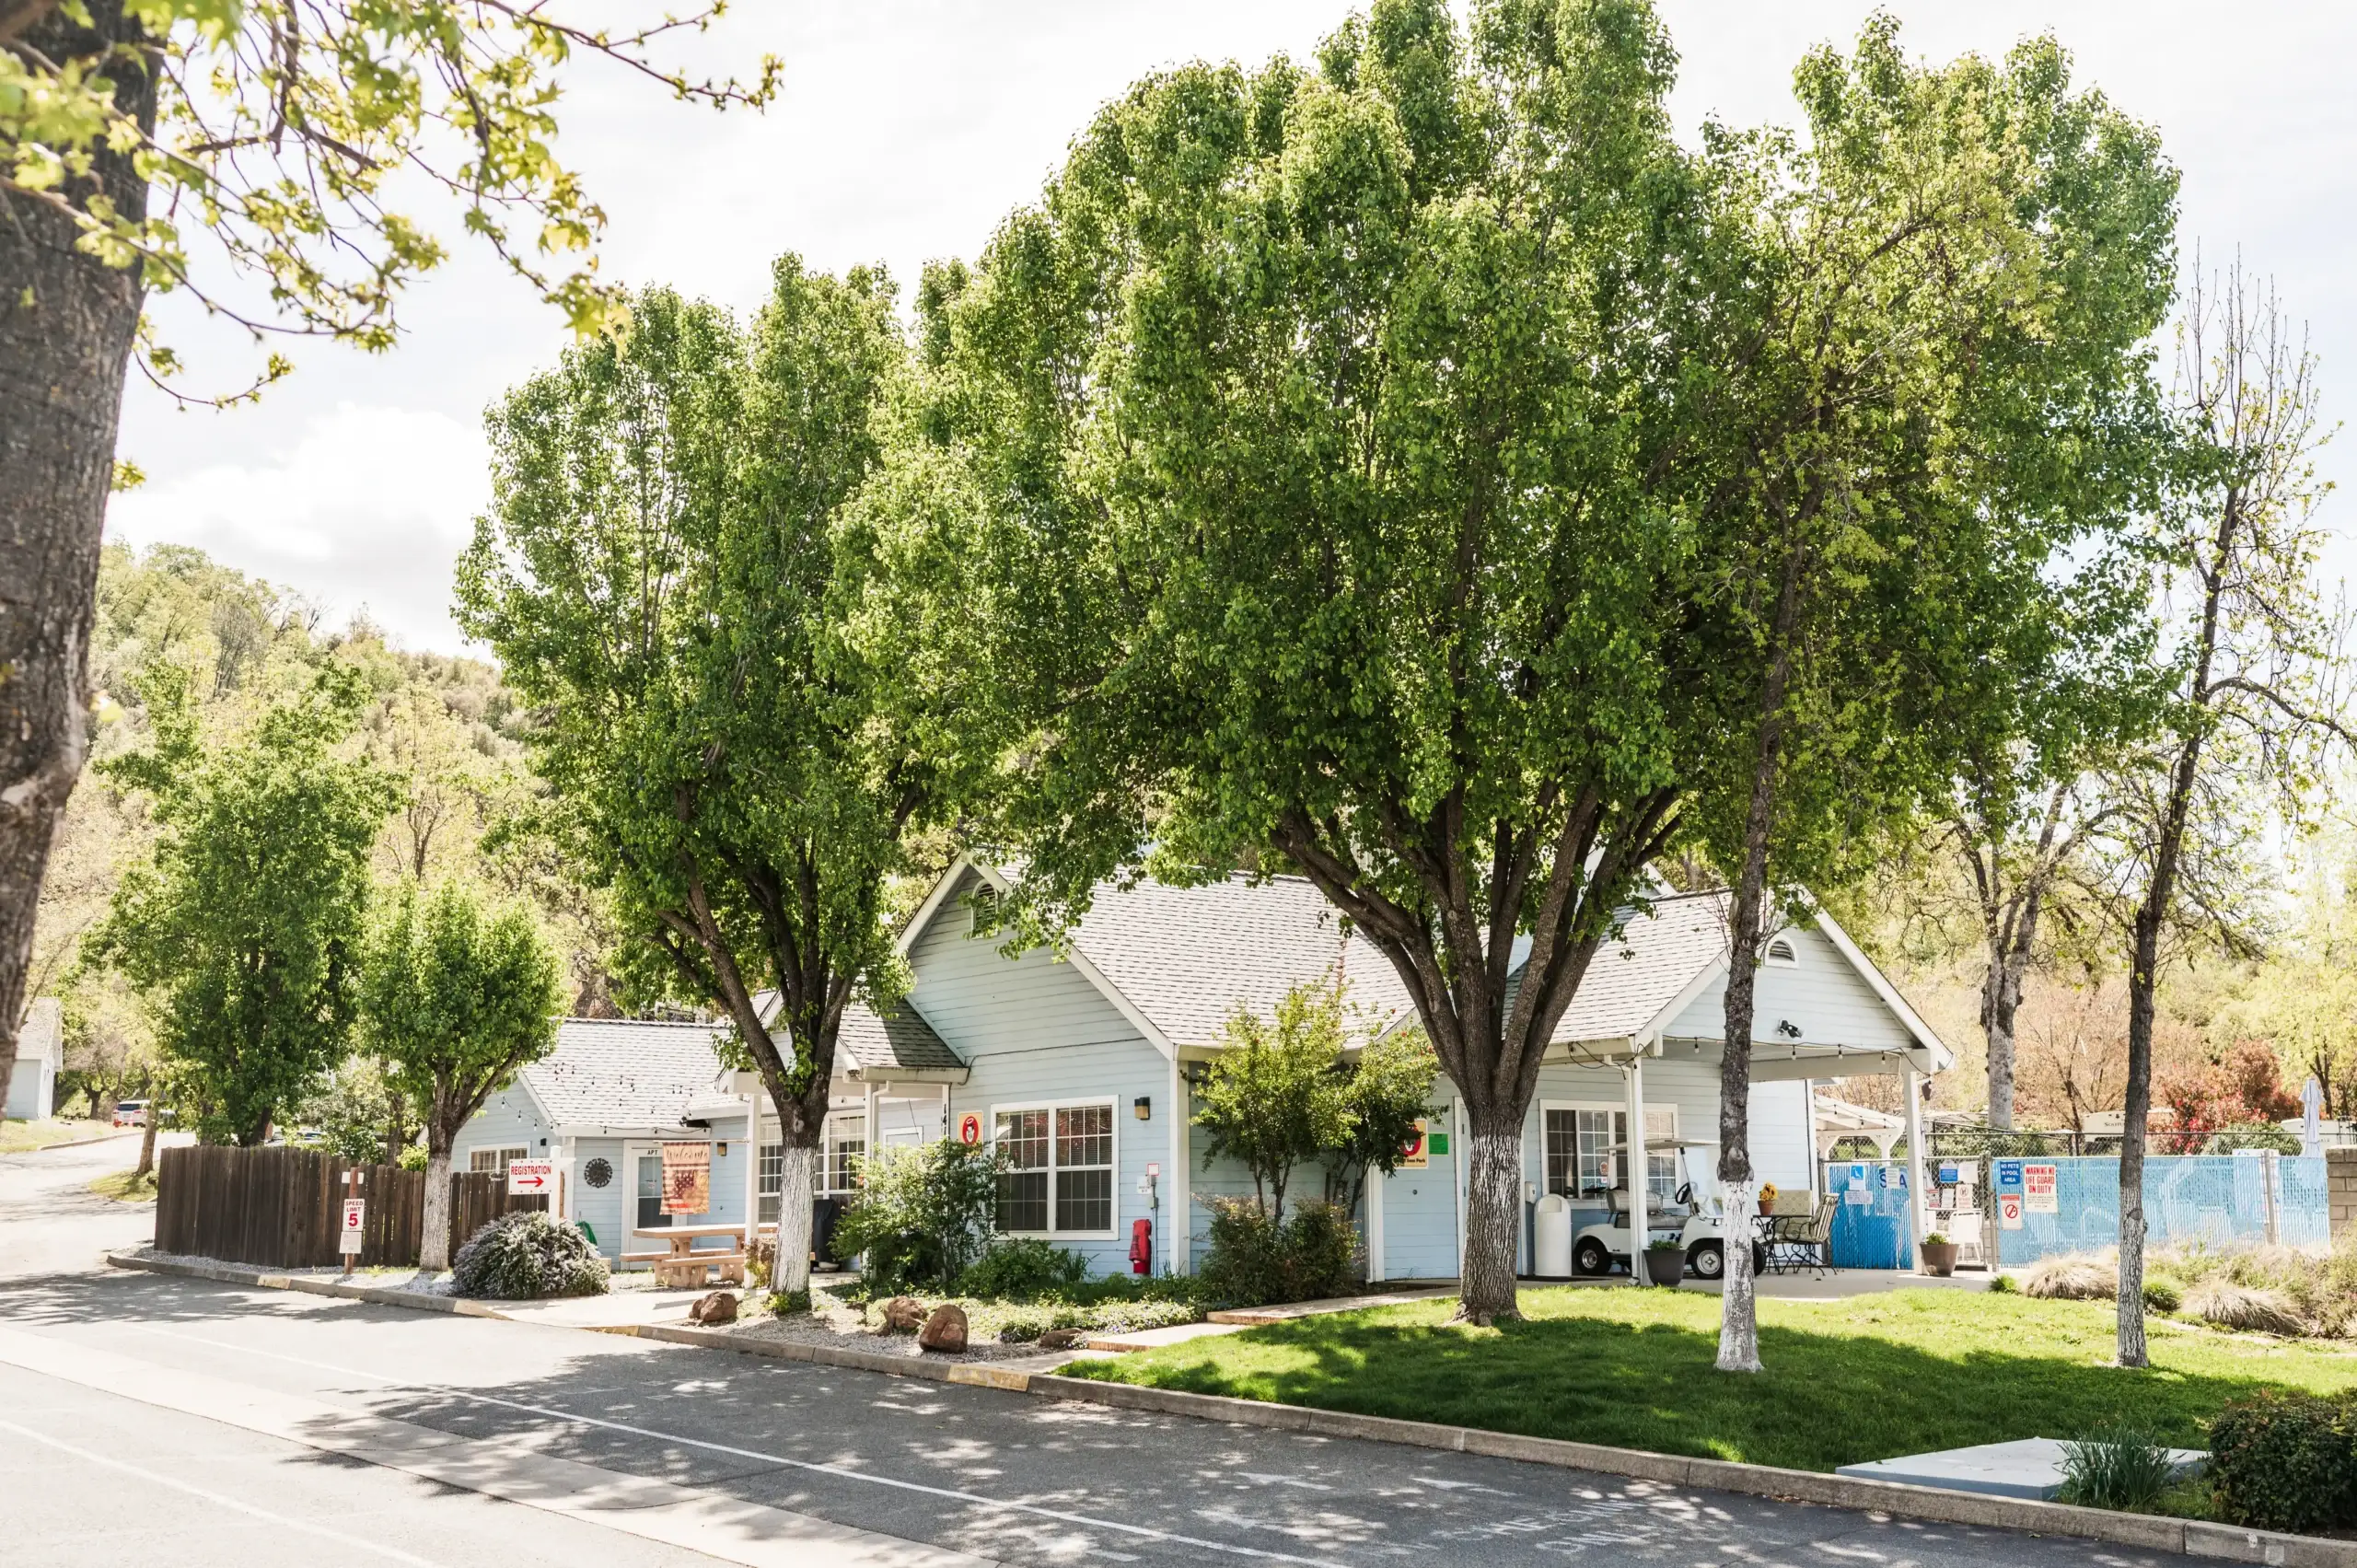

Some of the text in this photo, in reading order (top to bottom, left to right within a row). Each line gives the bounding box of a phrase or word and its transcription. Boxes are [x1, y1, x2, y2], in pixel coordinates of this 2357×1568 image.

[664, 1146, 709, 1160] Welcome
[510, 1165, 552, 1175] REGISTRATION
[2026, 1167, 2055, 1175] WARNING NO
[1879, 1173, 1908, 1189] SA
[2026, 1176, 2055, 1184] LIFE GUARD
[2028, 1185, 2051, 1193] ON DUTY
[348, 1213, 358, 1226] 5
